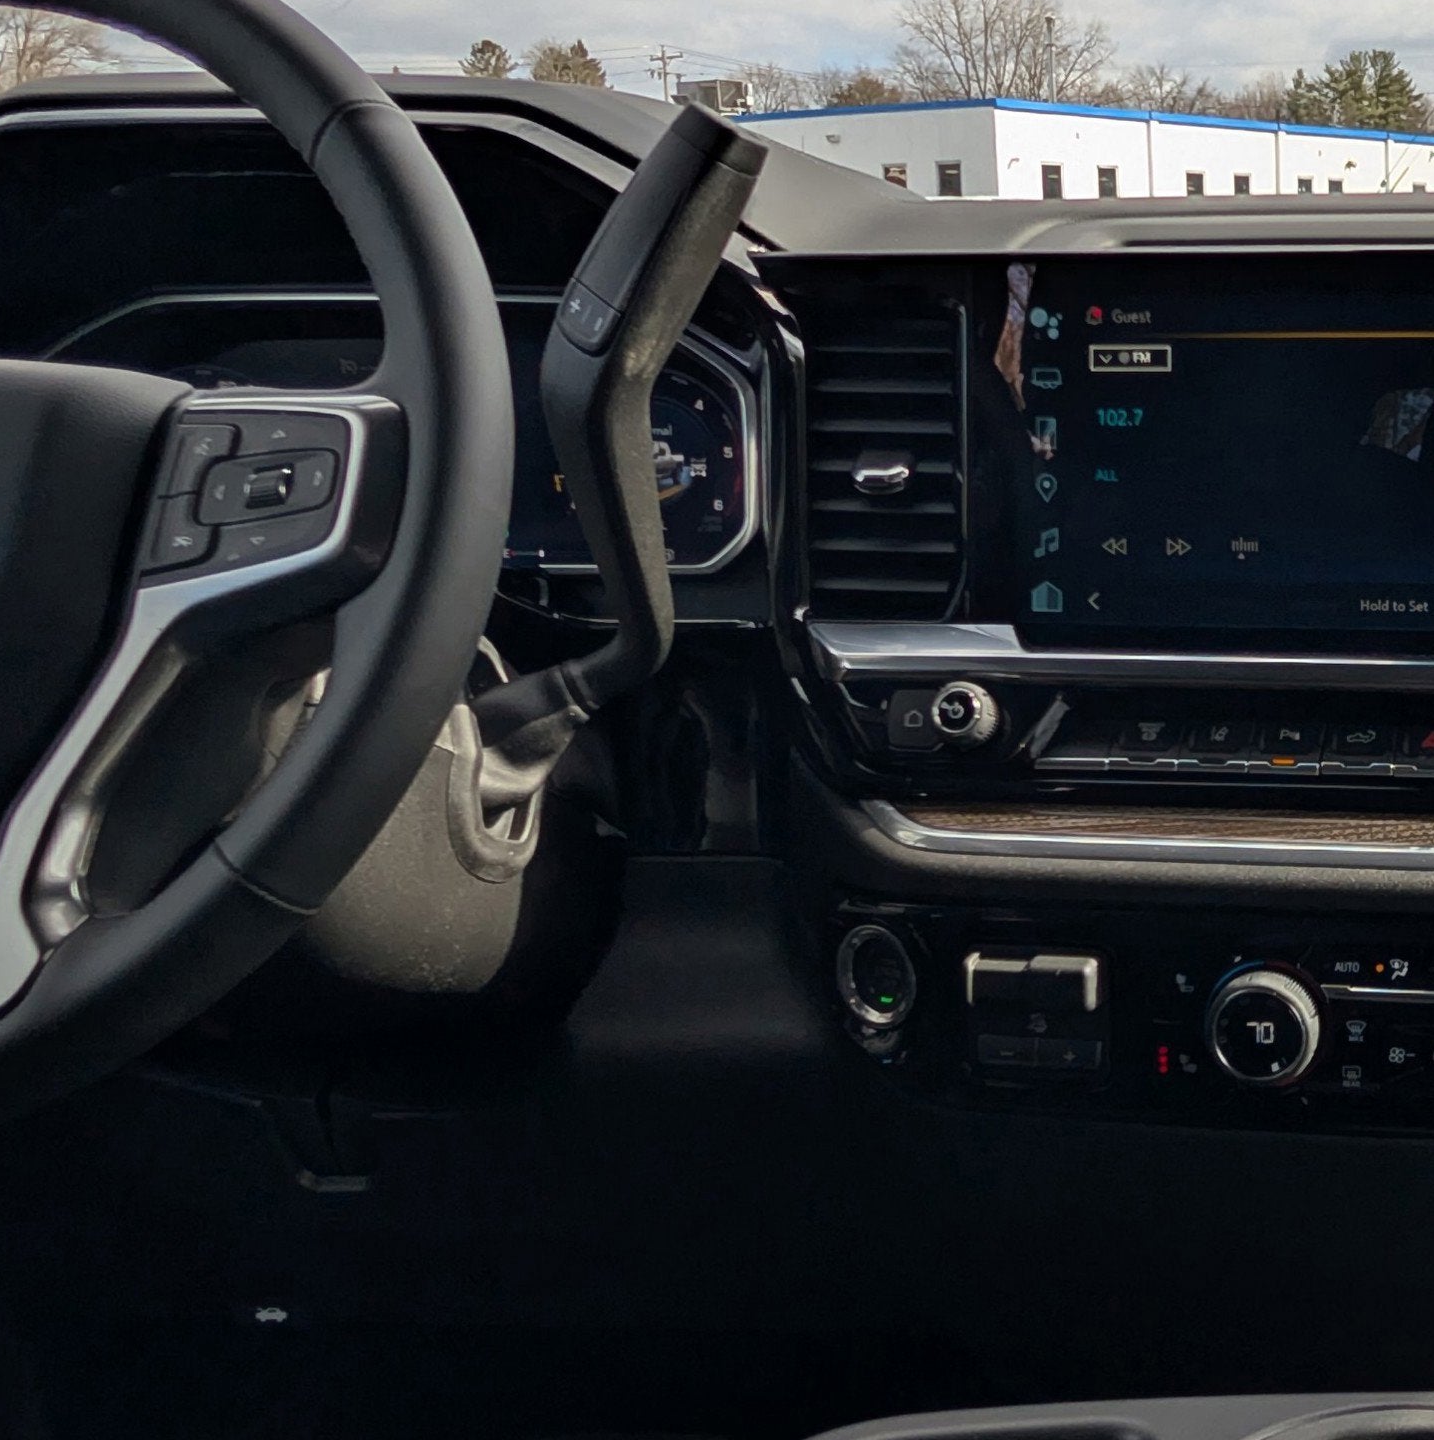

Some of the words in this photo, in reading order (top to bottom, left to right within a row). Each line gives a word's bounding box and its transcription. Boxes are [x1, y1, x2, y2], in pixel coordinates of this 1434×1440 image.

[1111, 308, 1152, 326] Guest
[1131, 350, 1152, 365] FM
[1096, 407, 1144, 428] 102.7
[1095, 468, 1119, 483] ALL
[1359, 597, 1389, 614] Hold
[1392, 600, 1405, 614] to
[1409, 598, 1429, 614] Set
[1334, 960, 1360, 974] AUTO
[1246, 1020, 1275, 1045] 70
